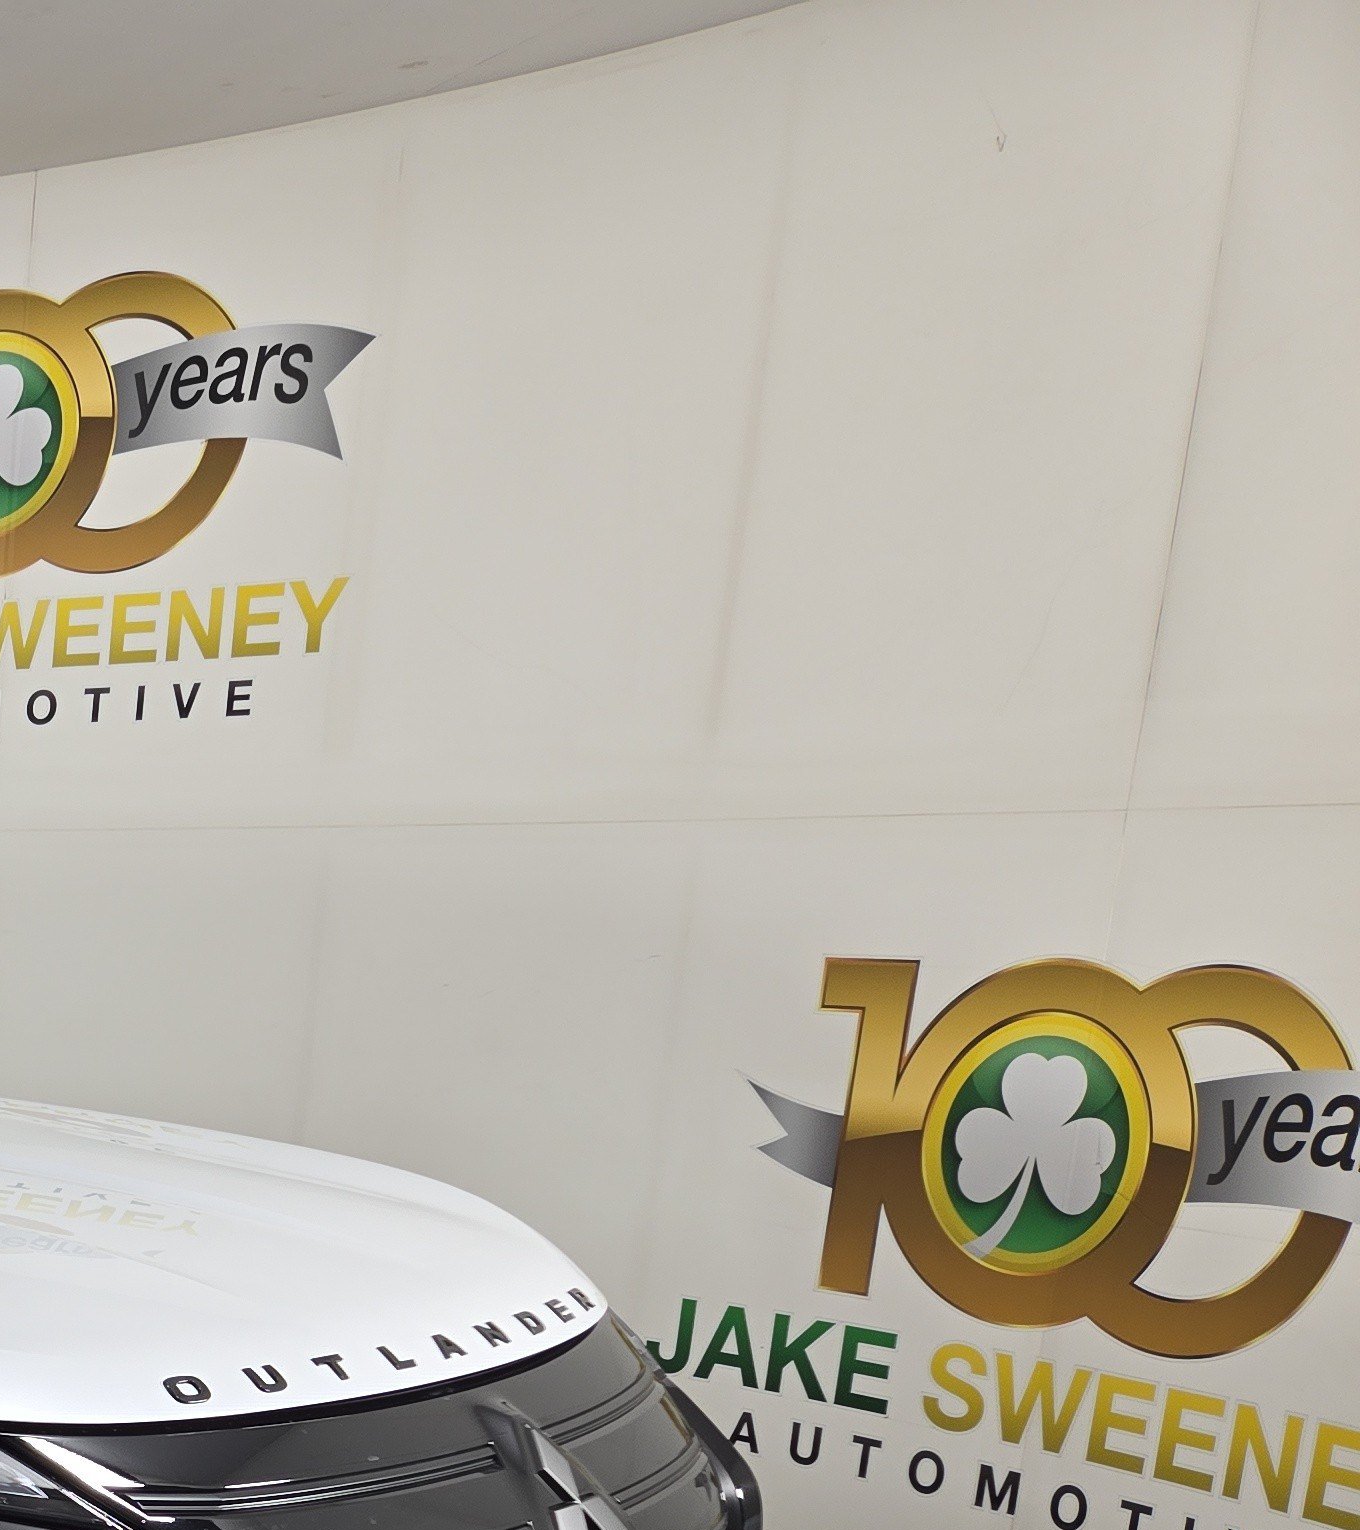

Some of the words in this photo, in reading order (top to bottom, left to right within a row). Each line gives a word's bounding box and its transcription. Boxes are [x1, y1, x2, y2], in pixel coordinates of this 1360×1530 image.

[126, 339, 315, 441] years
[817, 956, 1355, 1361] 100
[1205, 1089, 1360, 1186] yea
[161, 1285, 598, 1407] OUTLANDER
[644, 1296, 899, 1416] JAKE
